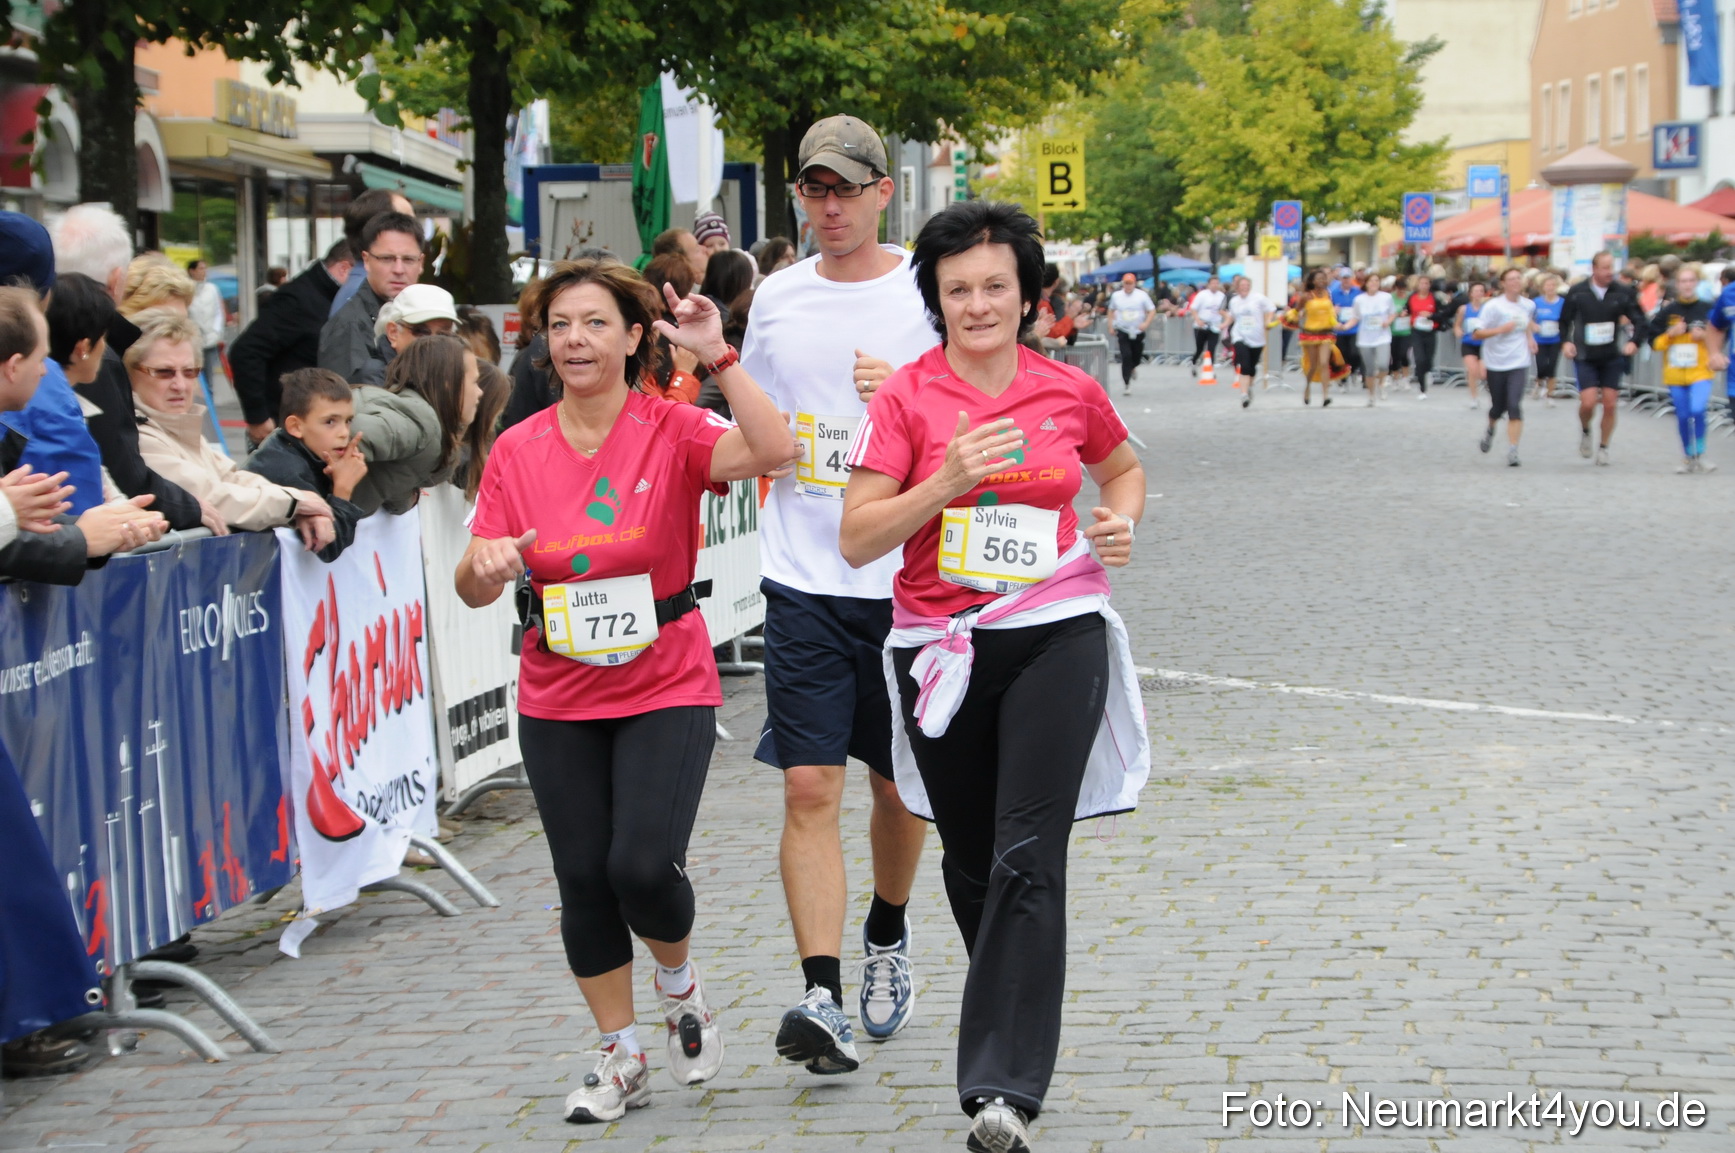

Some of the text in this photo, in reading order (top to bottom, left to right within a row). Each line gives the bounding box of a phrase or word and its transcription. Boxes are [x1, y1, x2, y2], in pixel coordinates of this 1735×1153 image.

[1042, 142, 1079, 155] Block
[1050, 162, 1072, 195] B
[1407, 227, 1431, 239] TAXI
[818, 422, 849, 441] Sven
[975, 507, 1017, 529] Sylvia
[534, 526, 646, 554] Laufbox.de
[945, 529, 953, 543] D
[982, 536, 1038, 567] 565
[572, 591, 608, 608] Jutta
[549, 619, 557, 632] D
[585, 611, 638, 640] 772
